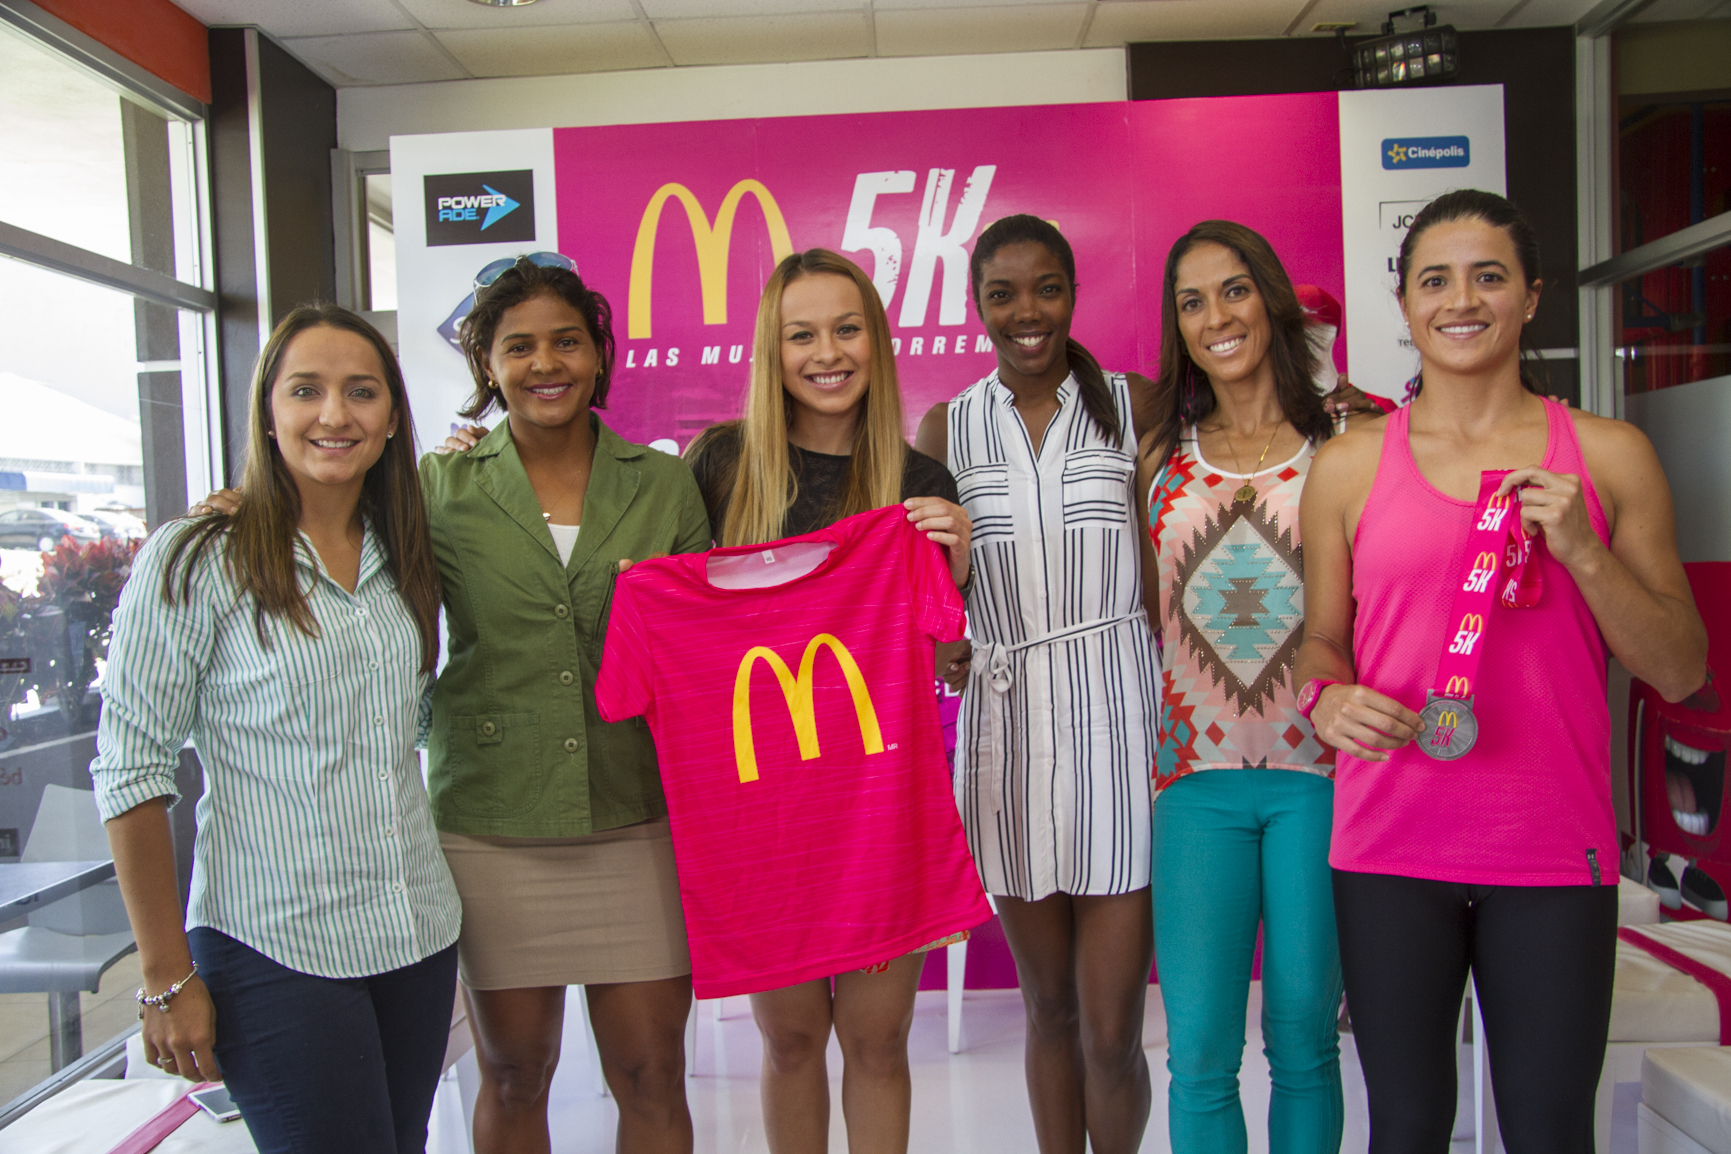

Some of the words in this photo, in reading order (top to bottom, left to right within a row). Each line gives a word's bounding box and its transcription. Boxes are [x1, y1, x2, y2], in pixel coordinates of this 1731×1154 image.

[1407, 145, 1464, 160] Cinépolis
[438, 194, 506, 210] POWER
[841, 165, 997, 327] 5K
[626, 348, 680, 368] LAS
[891, 334, 994, 356] ORREM
[1477, 508, 1508, 531] 5K
[1462, 569, 1495, 592] 5K
[1449, 630, 1480, 655] 5K
[1431, 726, 1456, 747] 5K
